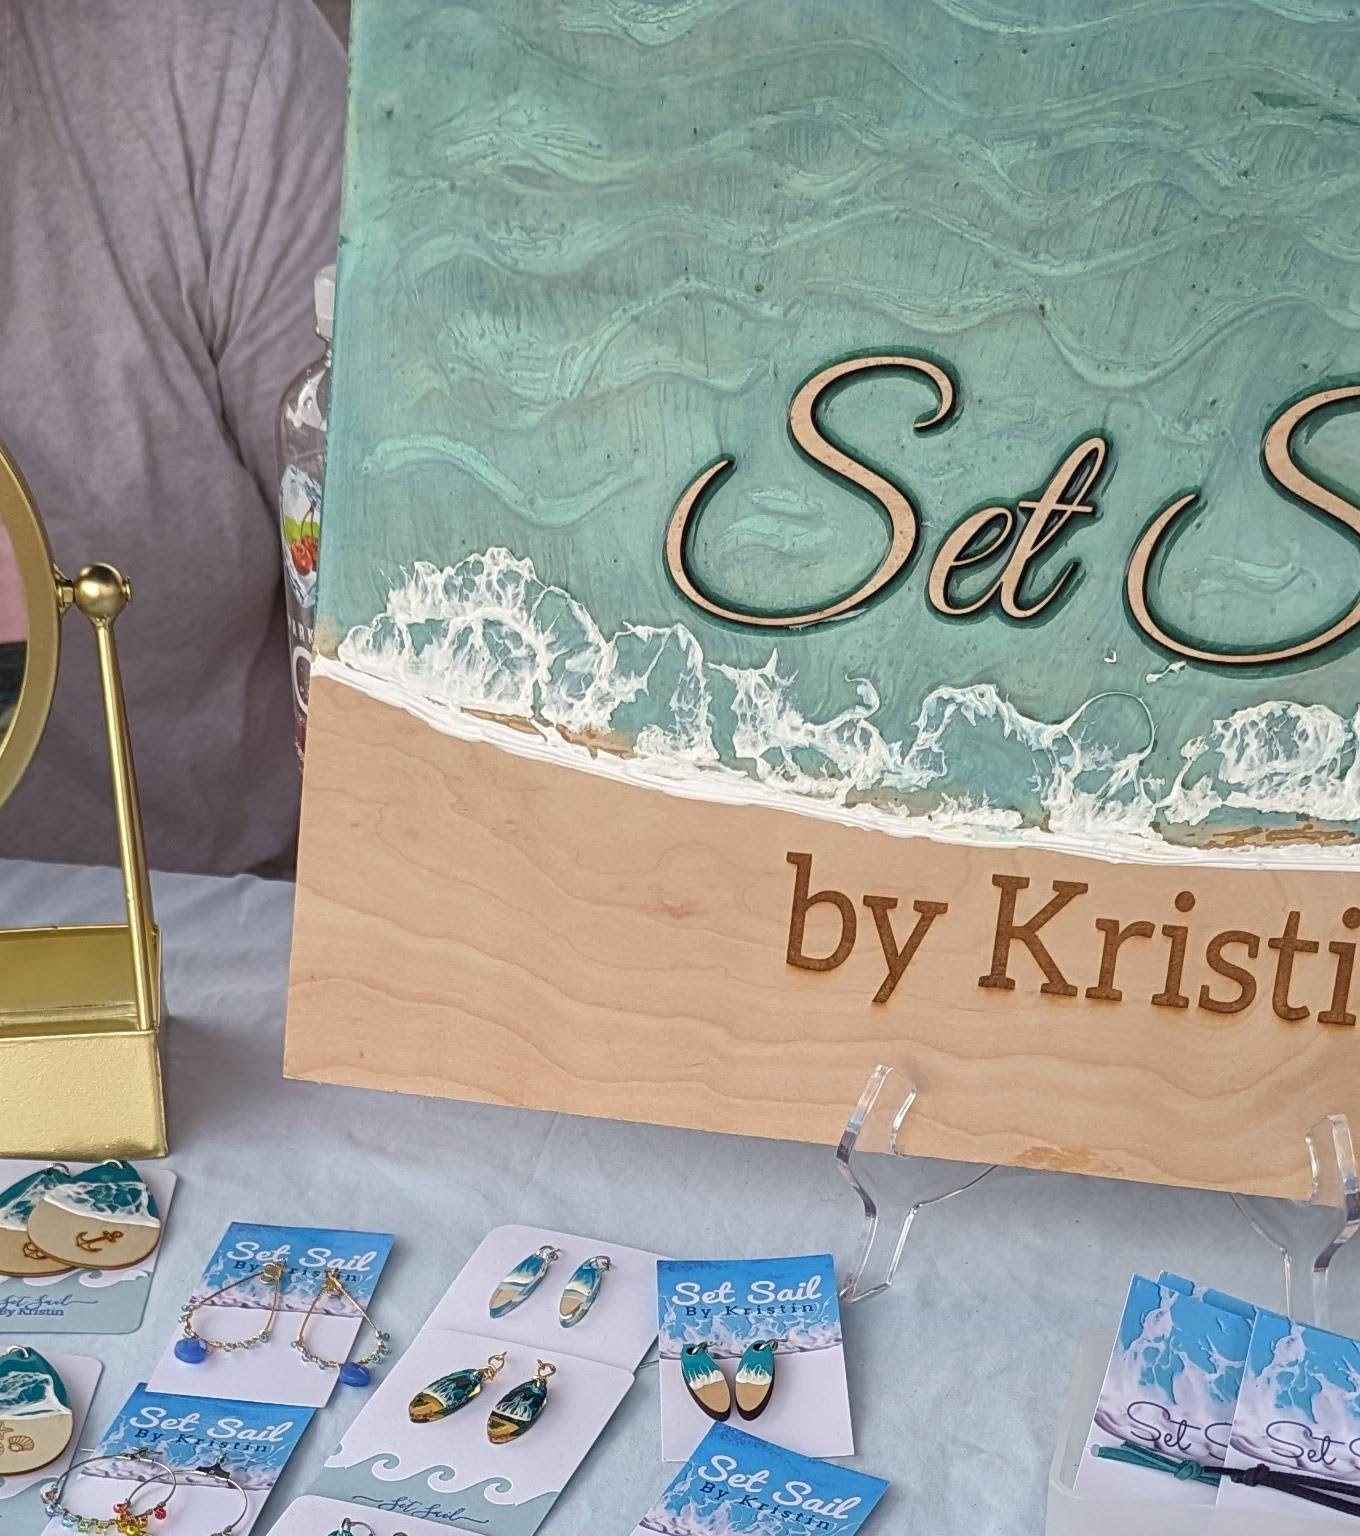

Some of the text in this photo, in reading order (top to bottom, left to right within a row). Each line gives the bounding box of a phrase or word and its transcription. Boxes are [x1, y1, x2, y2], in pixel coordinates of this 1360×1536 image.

[664, 354, 1112, 630] Set
[784, 851, 948, 1004] by
[226, 1241, 377, 1272] Set Sail
[233, 1260, 260, 1273] By
[671, 1275, 822, 1305] Set Sail
[686, 1304, 815, 1318] By Kristin
[129, 1406, 293, 1442] Set Sail
[134, 1428, 267, 1453] By Kristin
[1127, 1401, 1201, 1452] Set
[1266, 1420, 1346, 1466] Set
[697, 1455, 862, 1519] Set Sail
[699, 1481, 830, 1530] By Kristin
